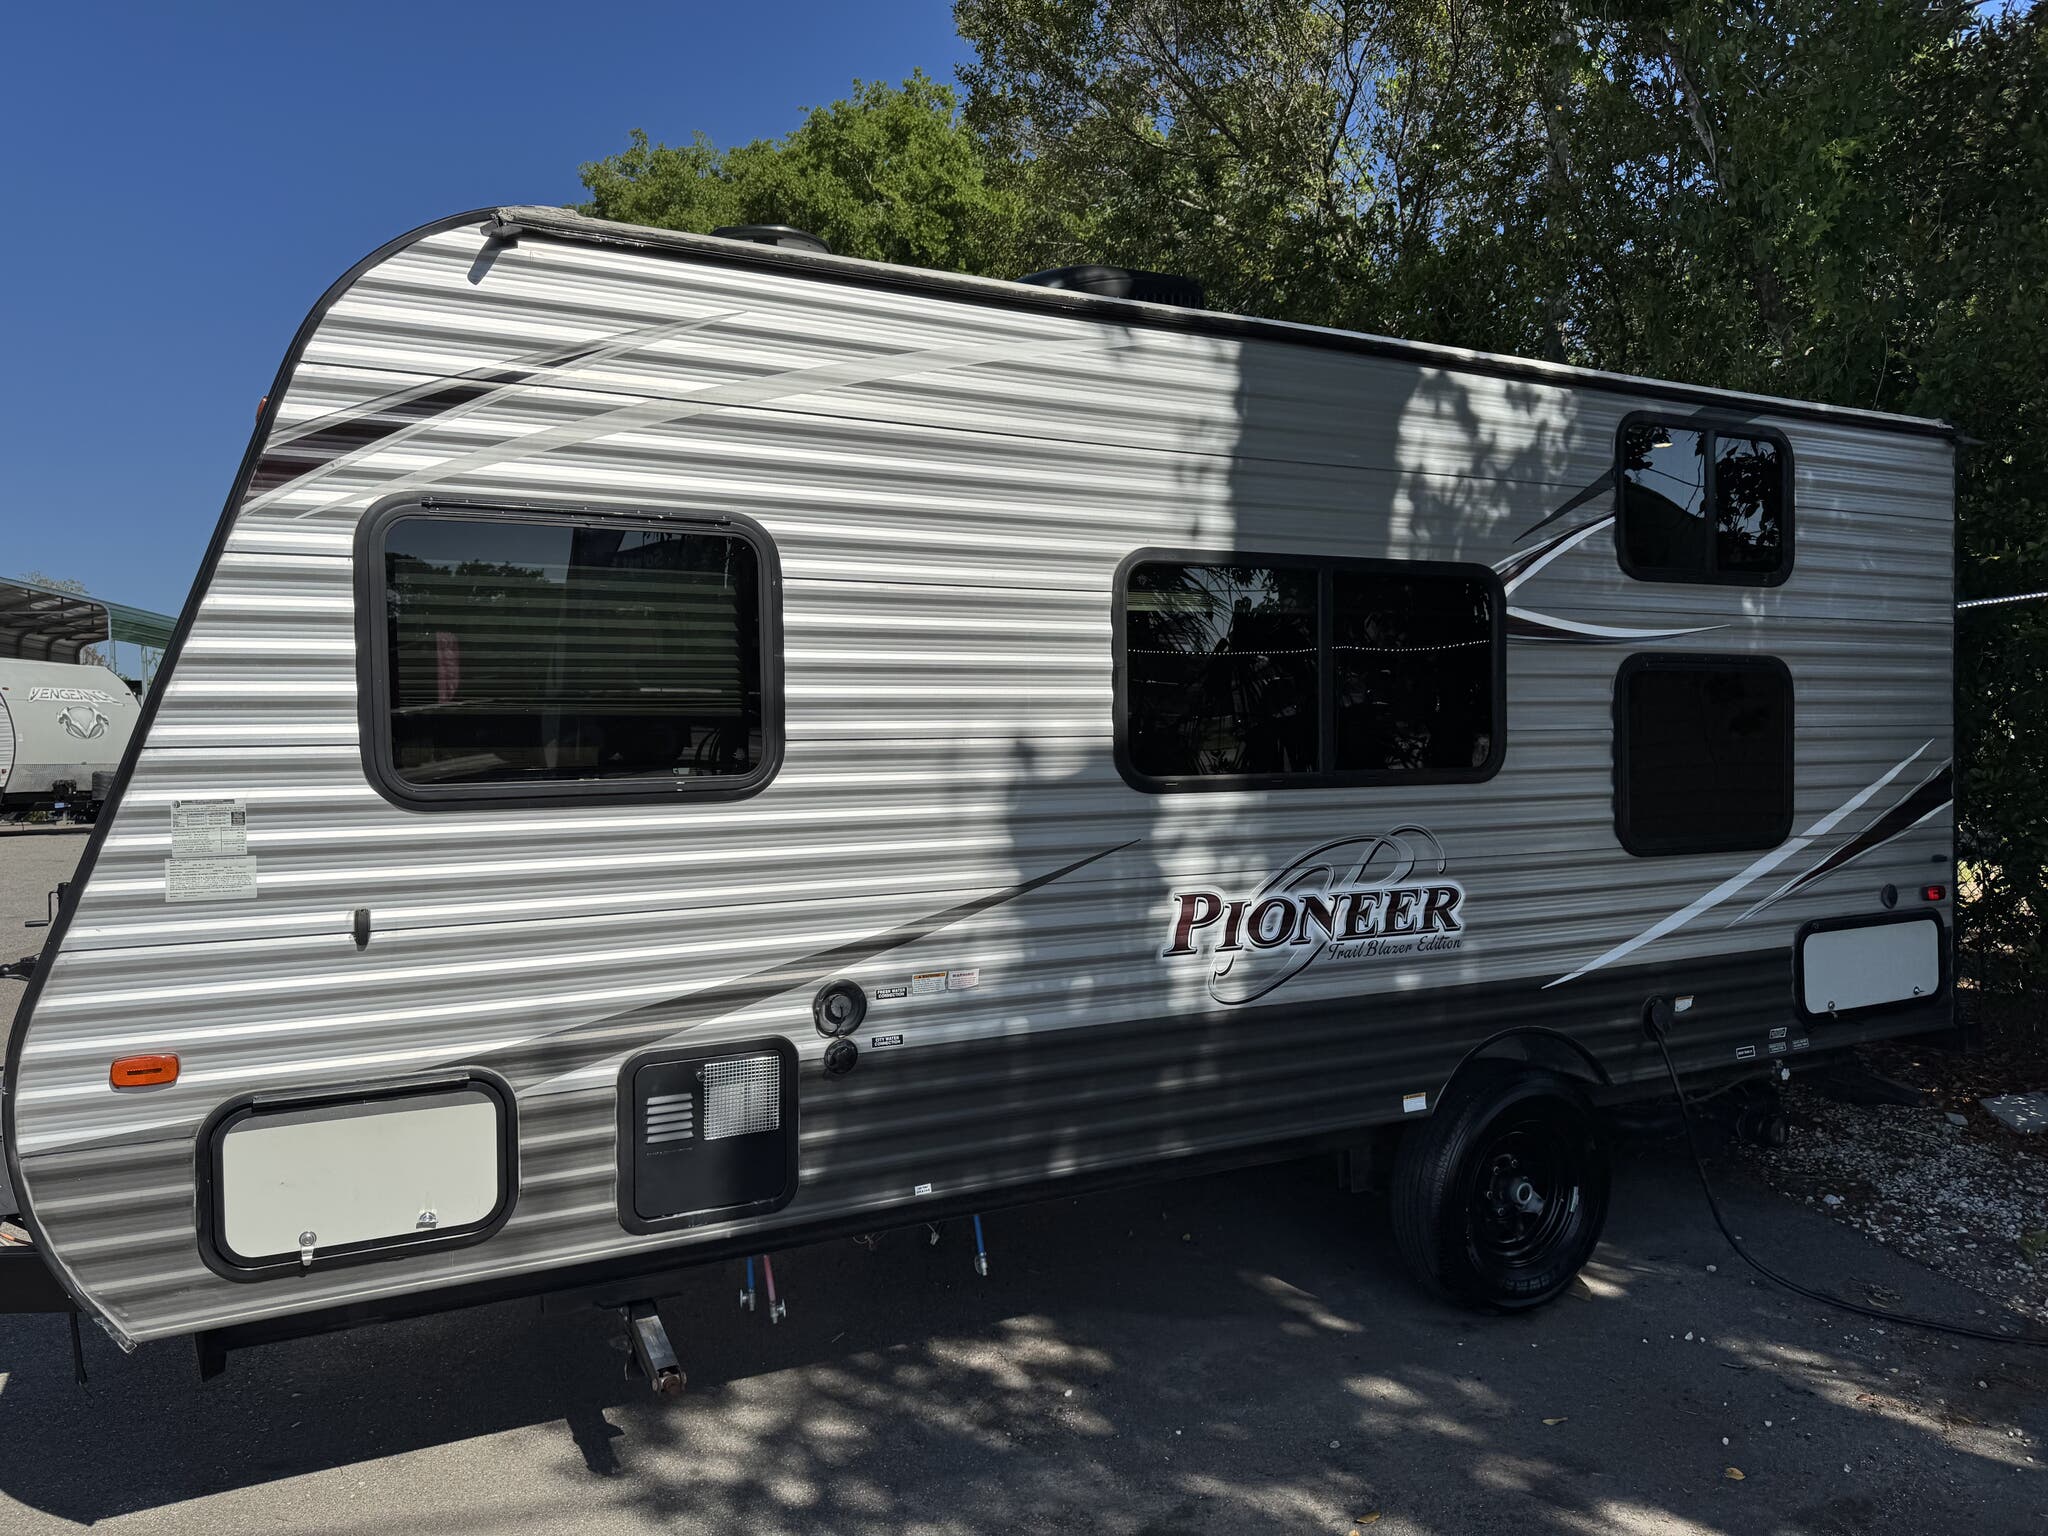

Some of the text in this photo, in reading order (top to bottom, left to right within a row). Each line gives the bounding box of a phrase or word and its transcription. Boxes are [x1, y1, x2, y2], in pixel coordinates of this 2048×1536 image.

[1162, 884, 1462, 957] PIONEER
[1328, 935, 1461, 960] Trail Blazer Edition
